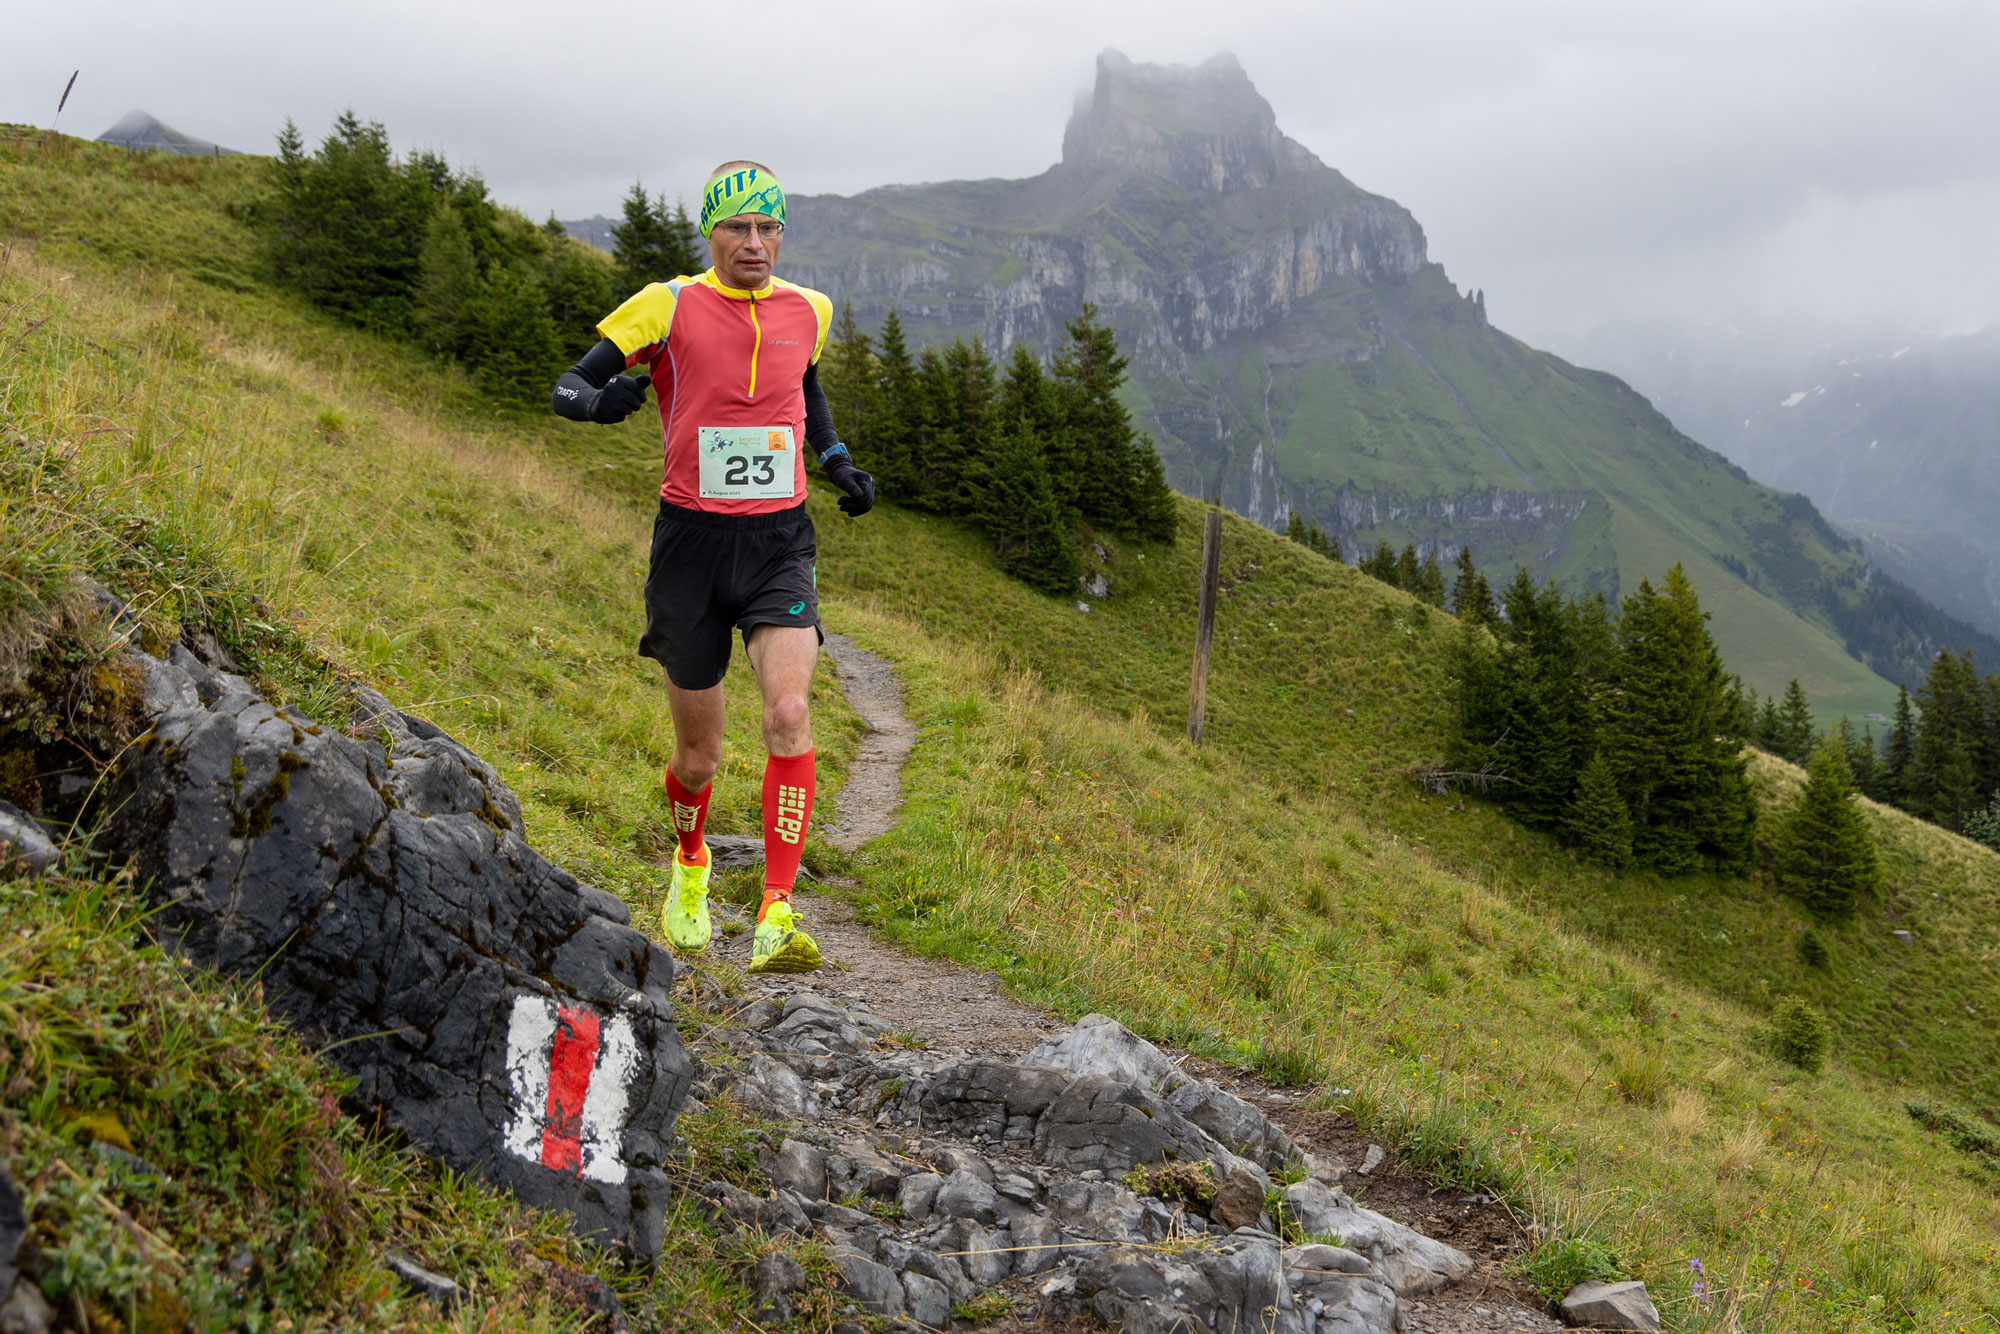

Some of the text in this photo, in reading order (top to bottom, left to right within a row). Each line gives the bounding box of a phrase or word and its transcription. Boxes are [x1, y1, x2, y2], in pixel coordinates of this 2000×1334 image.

[557, 385, 575, 398] CRAFT
[725, 456, 775, 485] 23
[774, 806, 804, 844] cep
